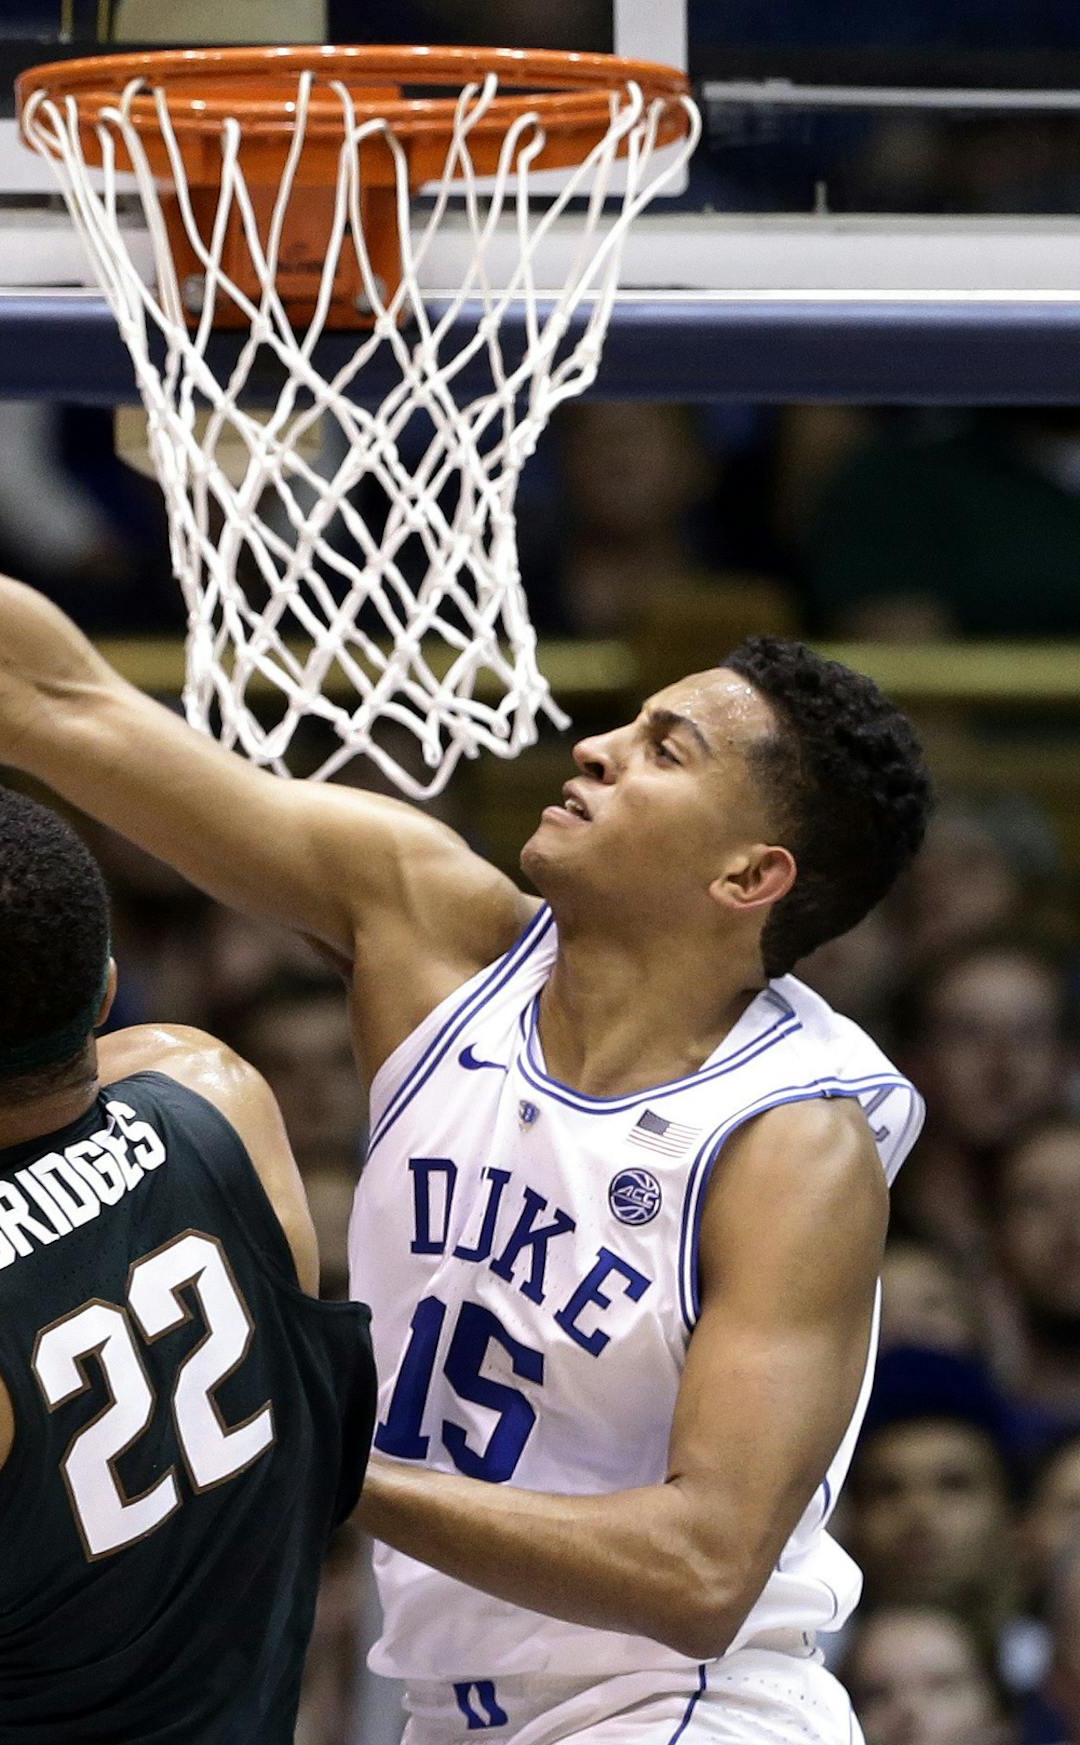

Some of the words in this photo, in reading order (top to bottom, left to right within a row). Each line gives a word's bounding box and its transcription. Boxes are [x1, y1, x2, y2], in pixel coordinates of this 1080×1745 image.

[615, 1185, 659, 1209] ACC
[31, 1228, 276, 1562] 22
[374, 1295, 544, 1483] 15
